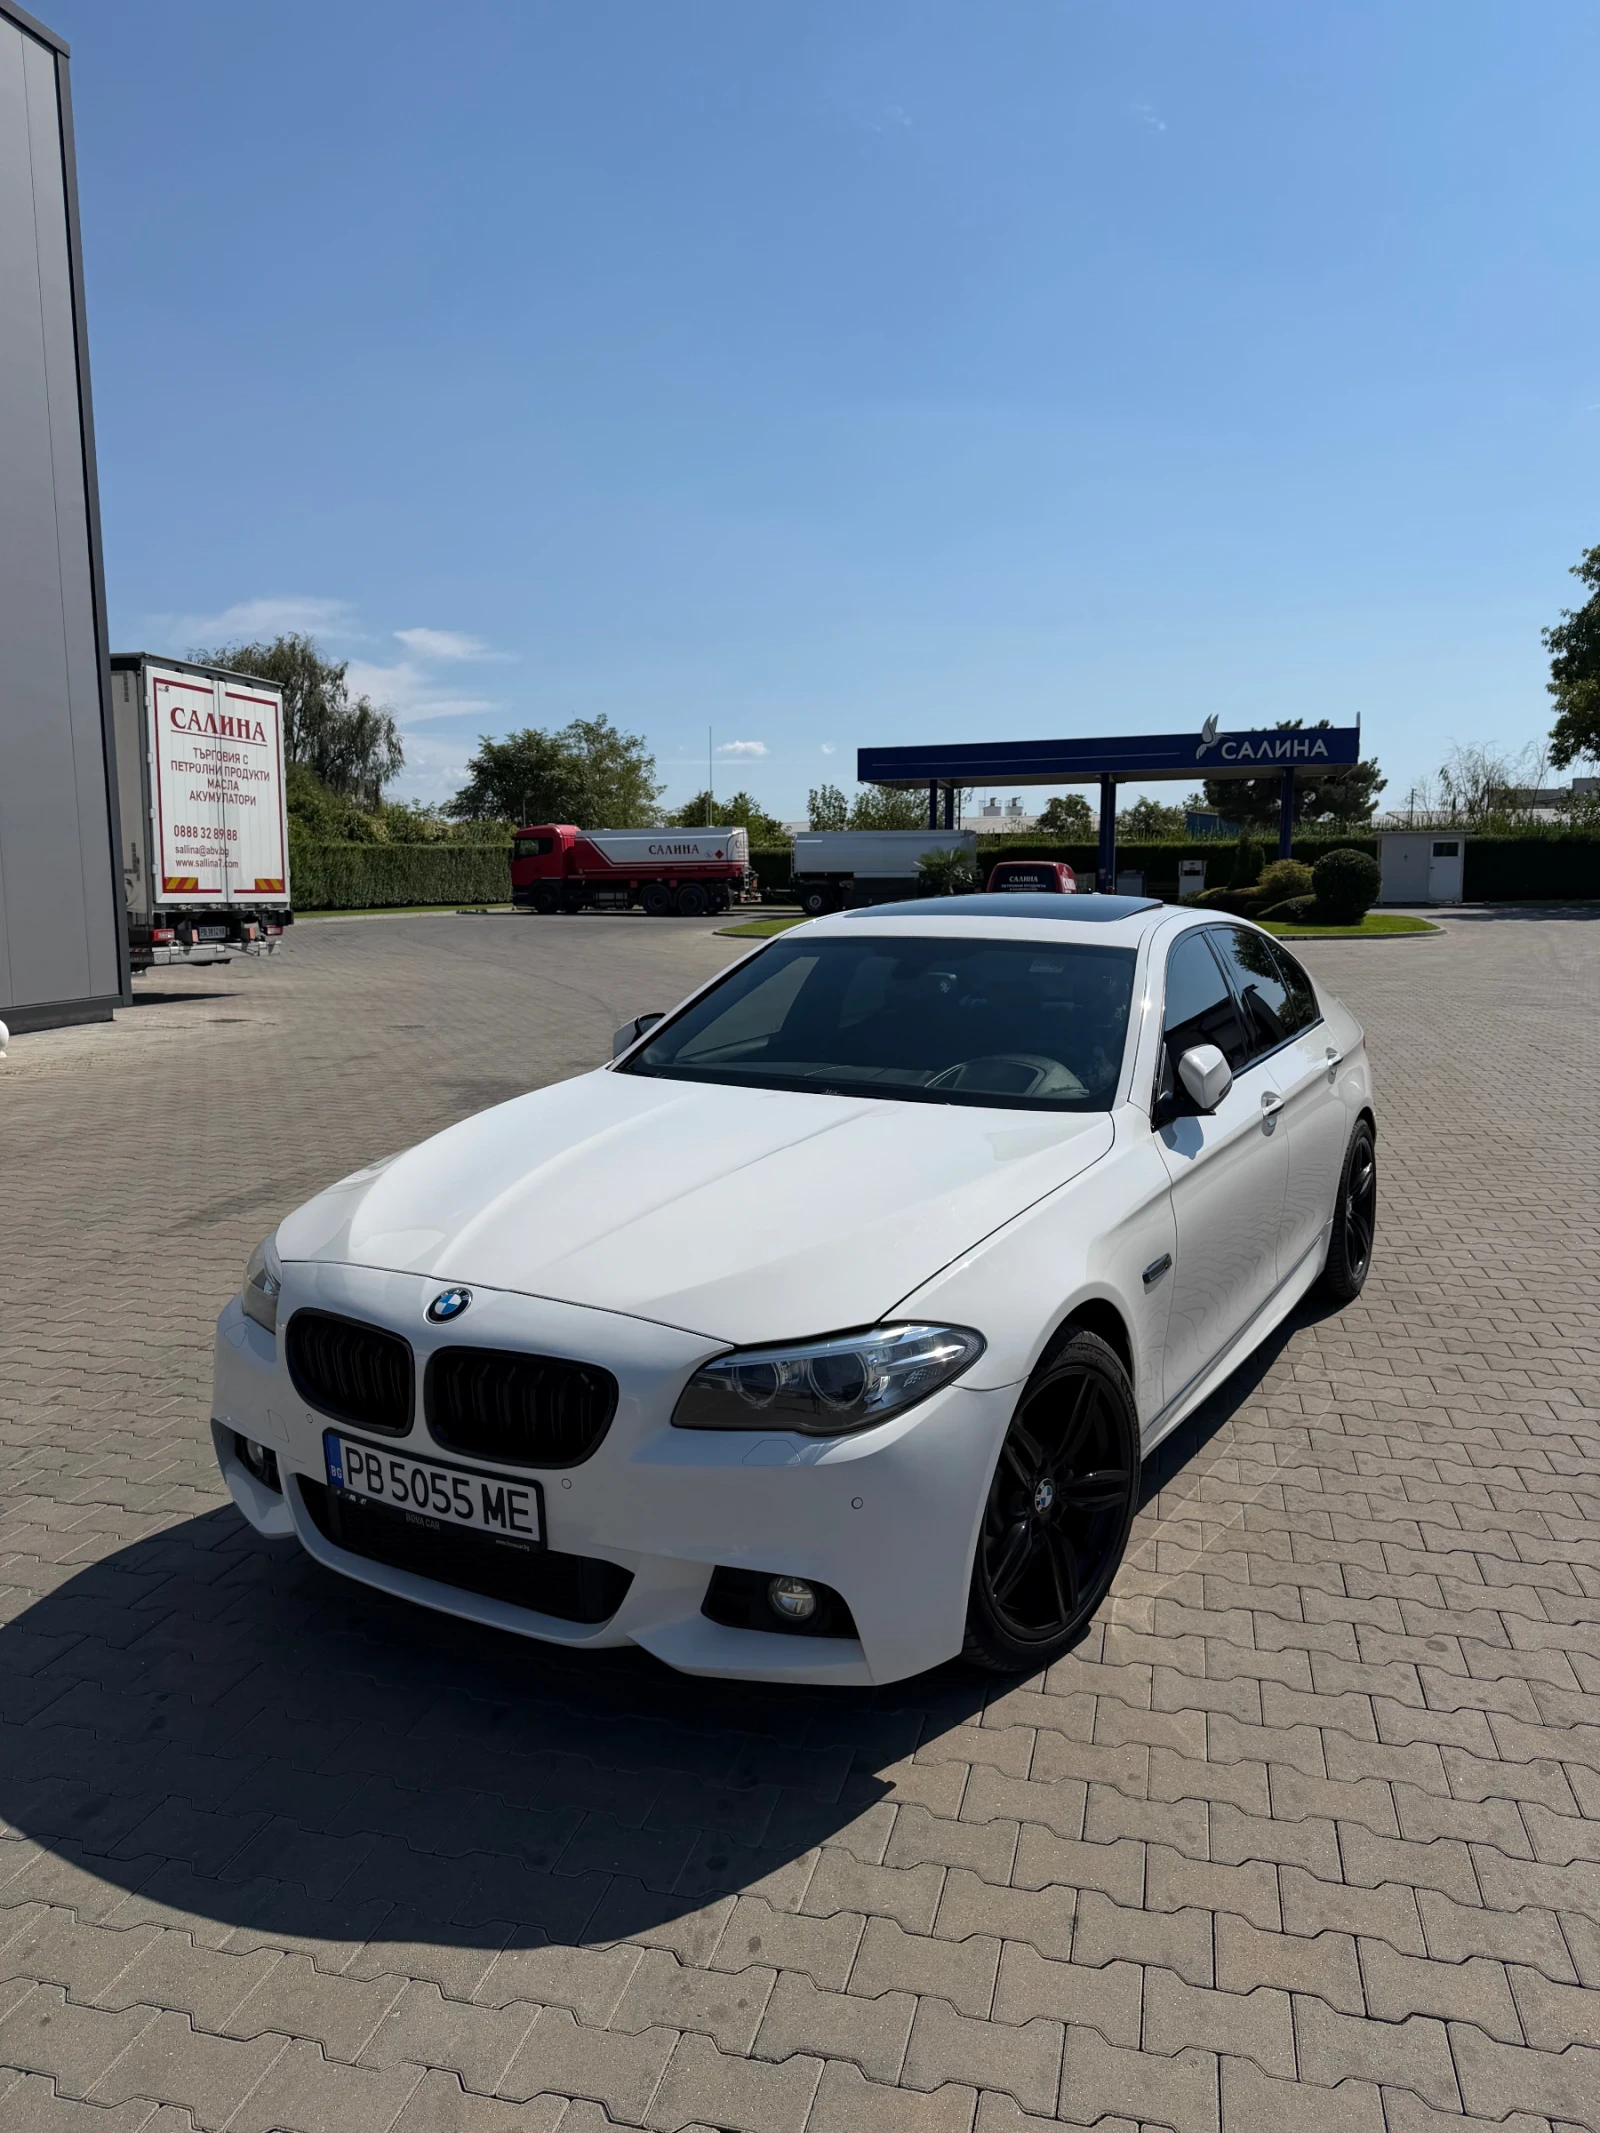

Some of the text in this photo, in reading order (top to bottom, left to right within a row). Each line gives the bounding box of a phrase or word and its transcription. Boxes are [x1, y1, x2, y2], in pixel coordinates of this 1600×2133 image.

[170, 706, 267, 742] САЛИНА
[193, 747, 249, 765] ТЪРГОВИЯ С
[1221, 738, 1329, 760] САЛИНА
[171, 760, 270, 782] ПЕТРОЛНИ ПРОДУКТИ
[207, 778, 240, 791] МАСЛА
[189, 790, 257, 806] АКУМУЛАТОРИ
[174, 824, 238, 841] 0888 32 89 88
[175, 844, 230, 858] sallina@abv.bg
[648, 843, 700, 855] САЛИНА
[175, 858, 239, 869] www.sallina7.com
[330, 1464, 343, 1479] BG
[345, 1446, 533, 1534] PB 5055 ME
[405, 1513, 440, 1531] BOVA CAR
